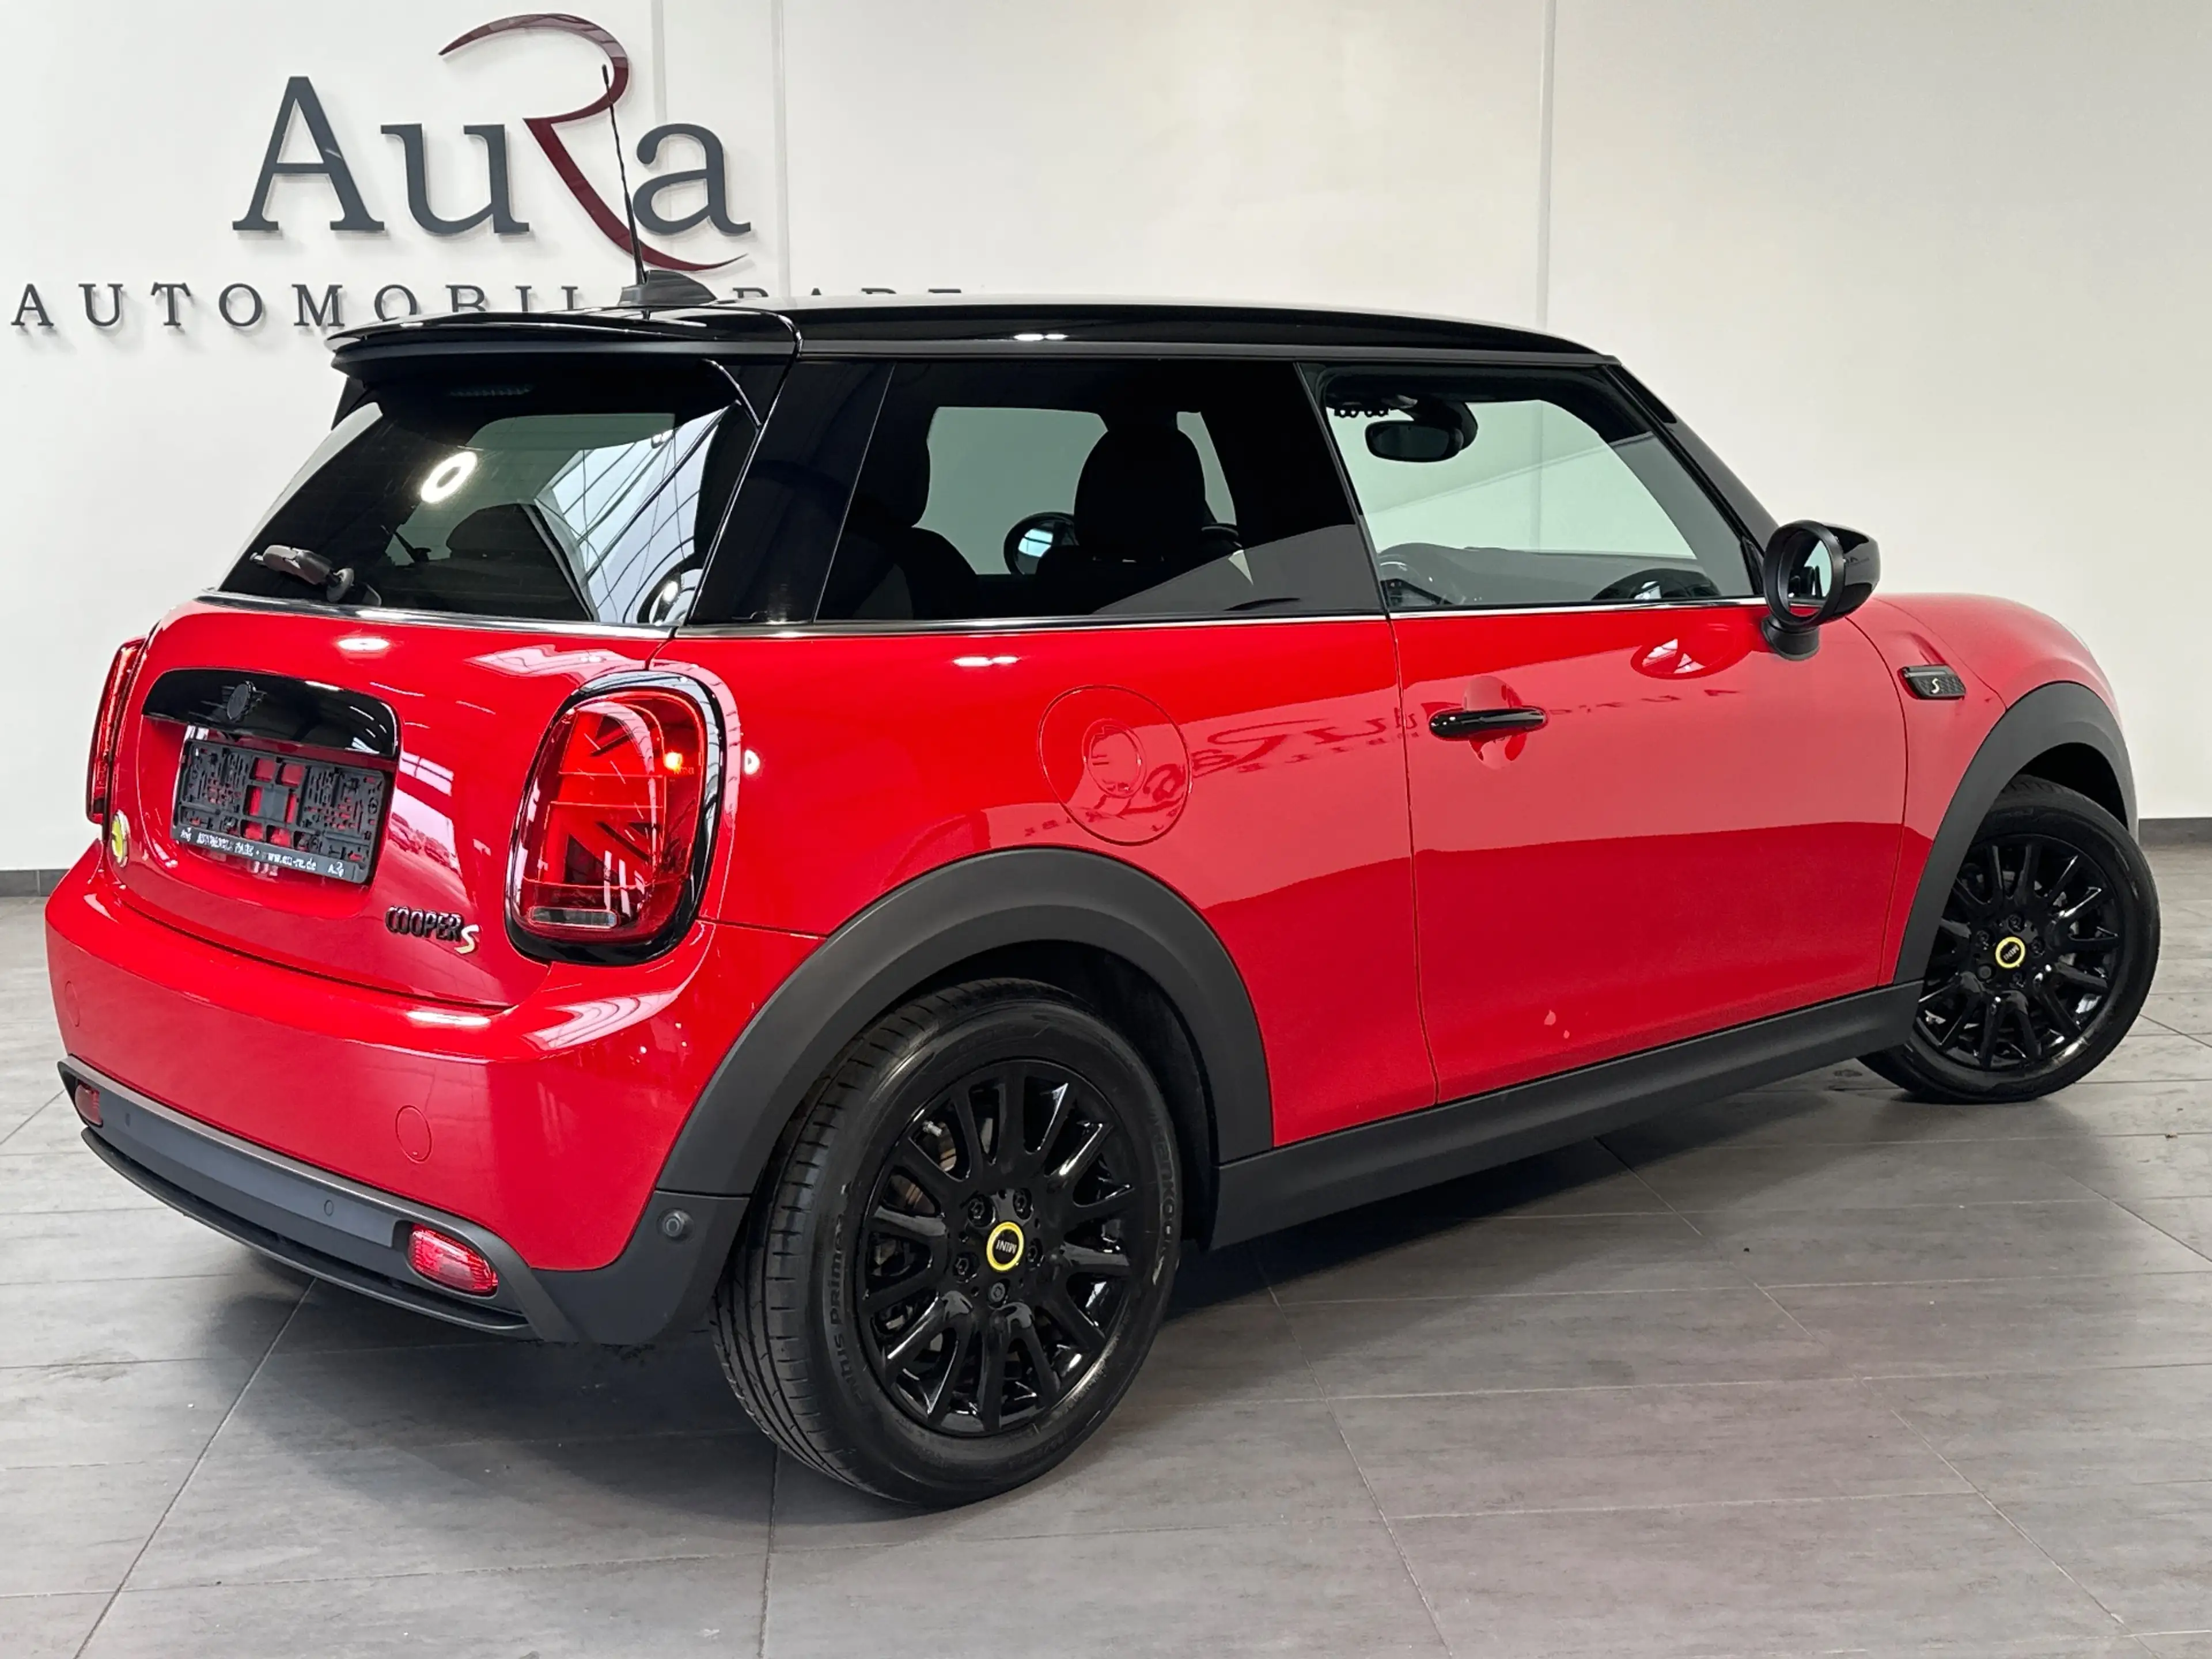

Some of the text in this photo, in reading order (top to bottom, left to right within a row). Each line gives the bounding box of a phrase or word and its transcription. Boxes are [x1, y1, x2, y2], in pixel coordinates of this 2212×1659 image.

[11, 282, 578, 327] AUTOMOBI
[1930, 677, 1941, 695] S
[385, 906, 480, 955] COOPER S
[2003, 944, 2020, 961] MINI
[995, 1239, 1018, 1255] MINI
